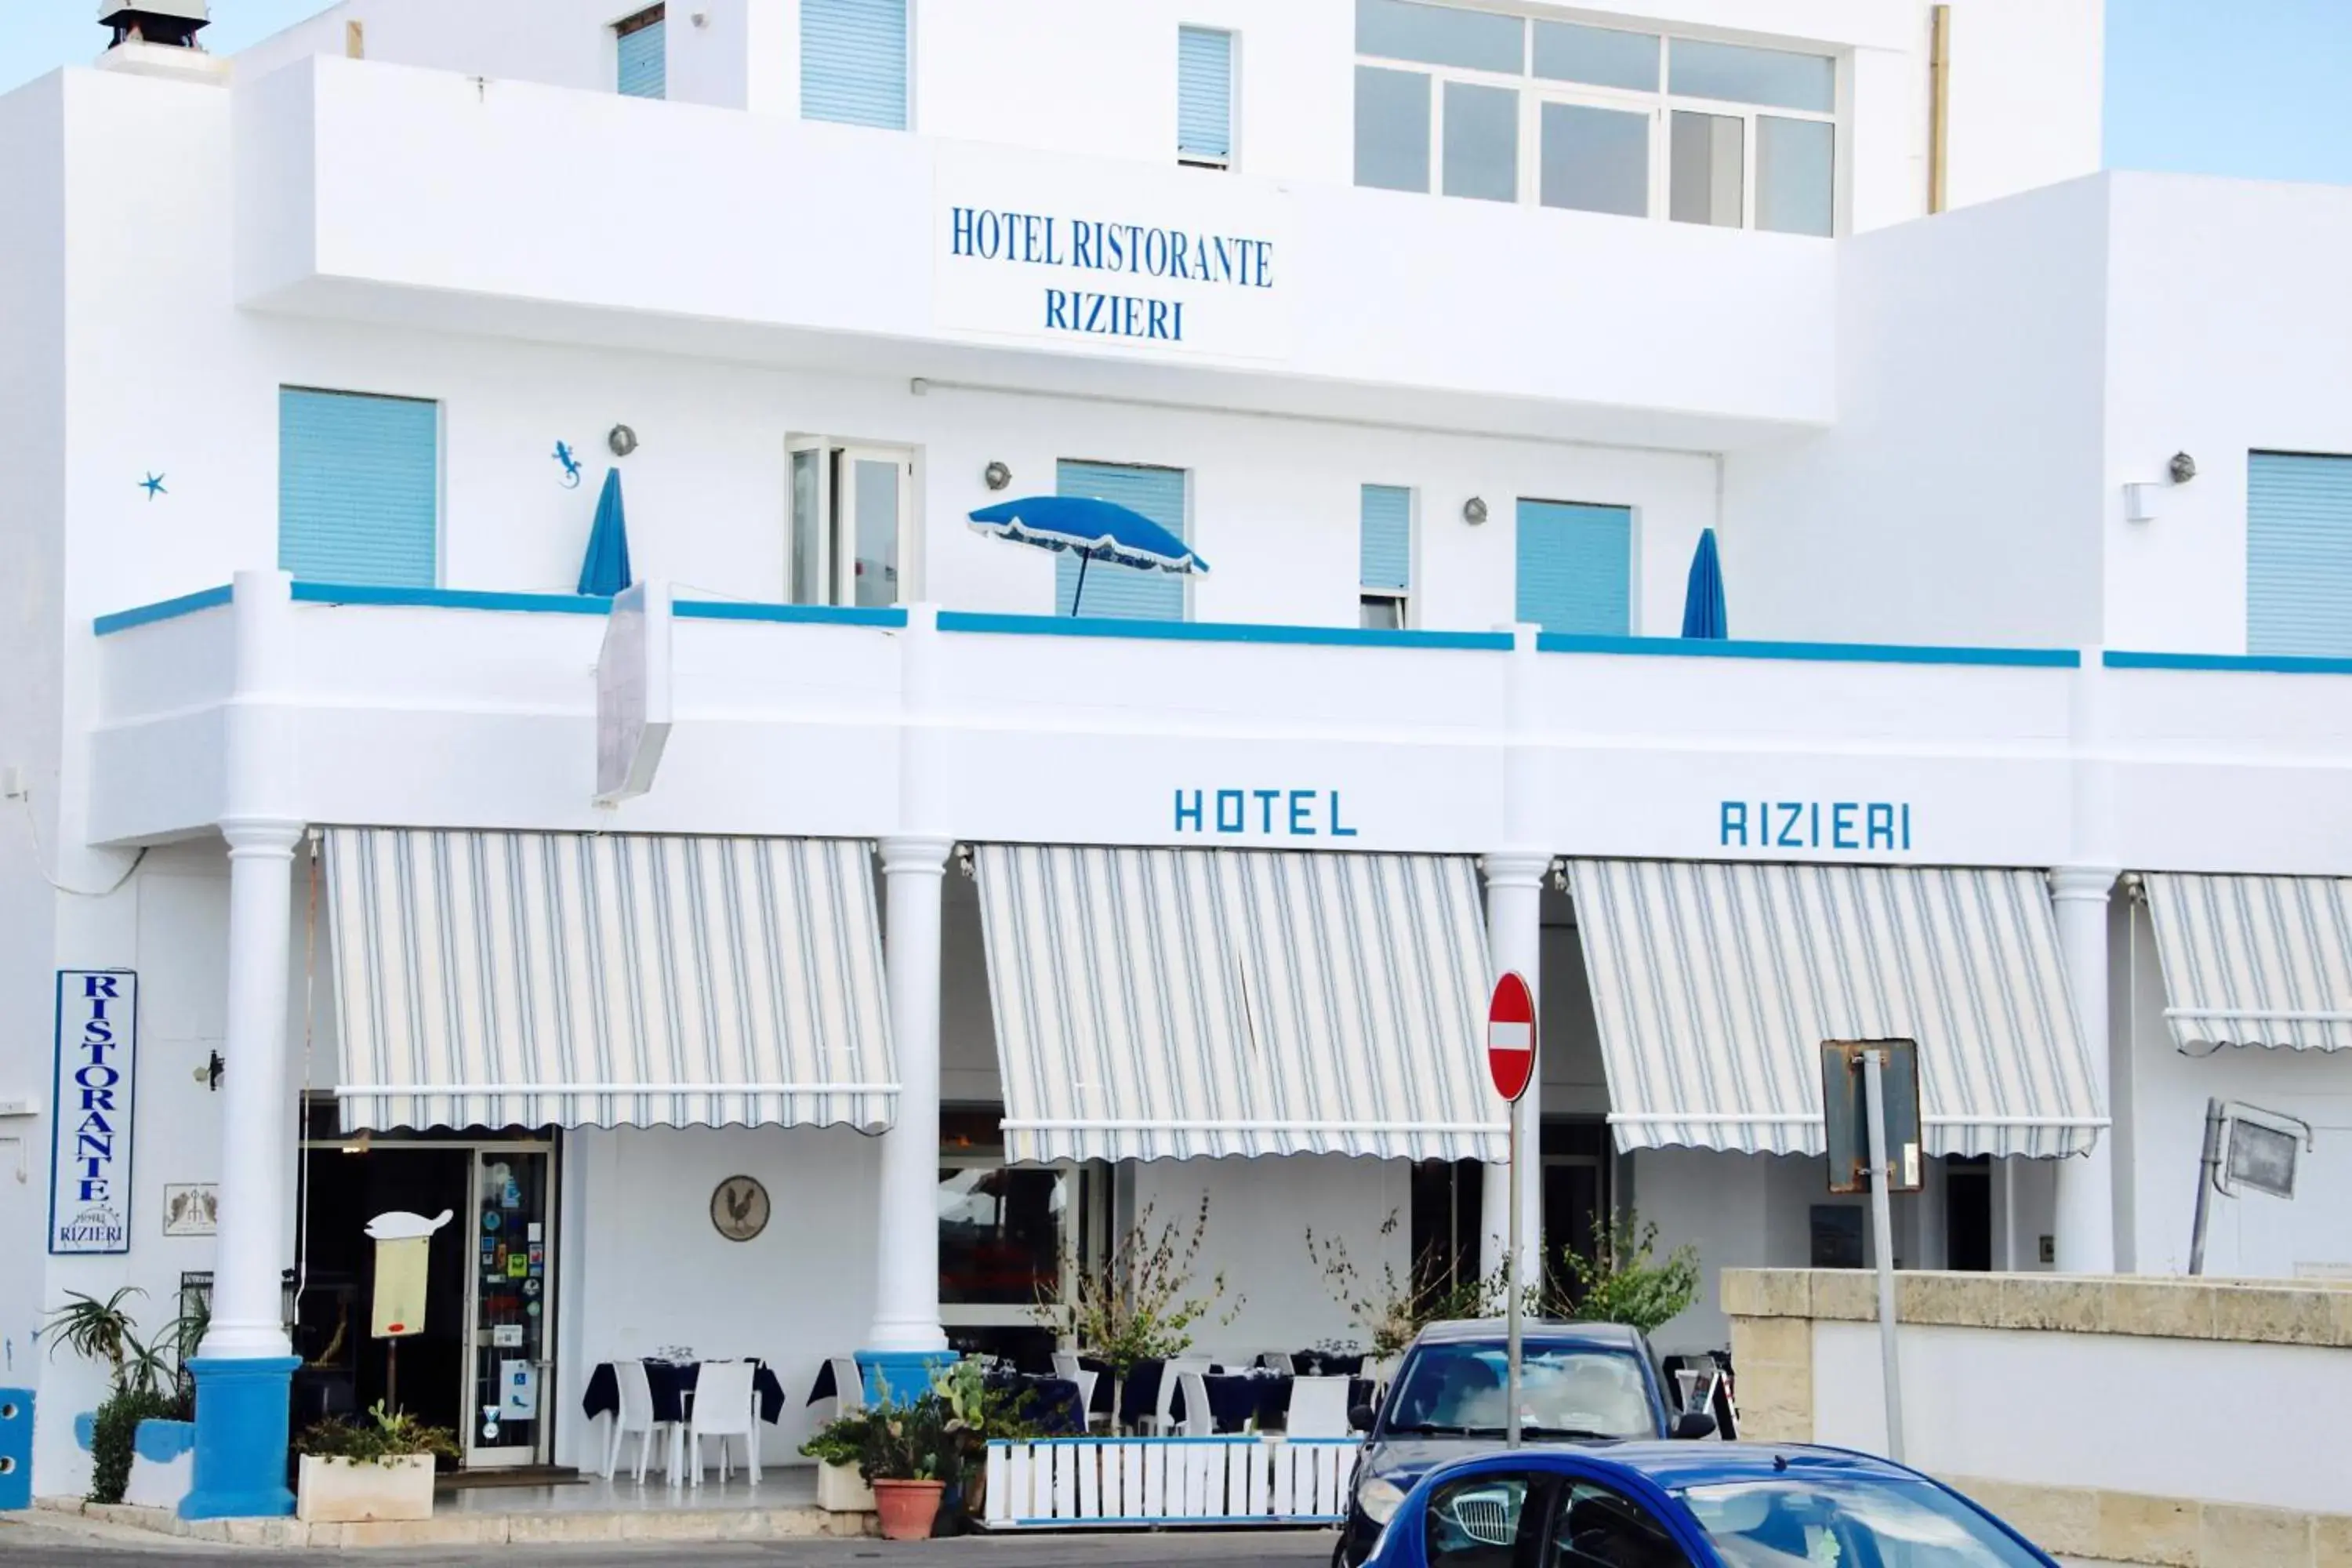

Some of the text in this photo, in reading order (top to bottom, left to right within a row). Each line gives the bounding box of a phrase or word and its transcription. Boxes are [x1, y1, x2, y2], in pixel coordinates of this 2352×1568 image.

[951, 207, 1274, 289] HOTEL RISTORANTE
[1044, 289, 1184, 342] RIZIERI
[1175, 789, 1910, 850] HOTEL RIZIERI
[75, 976, 119, 1202] RISTORANTE
[60, 1226, 122, 1241] RIZIERI
